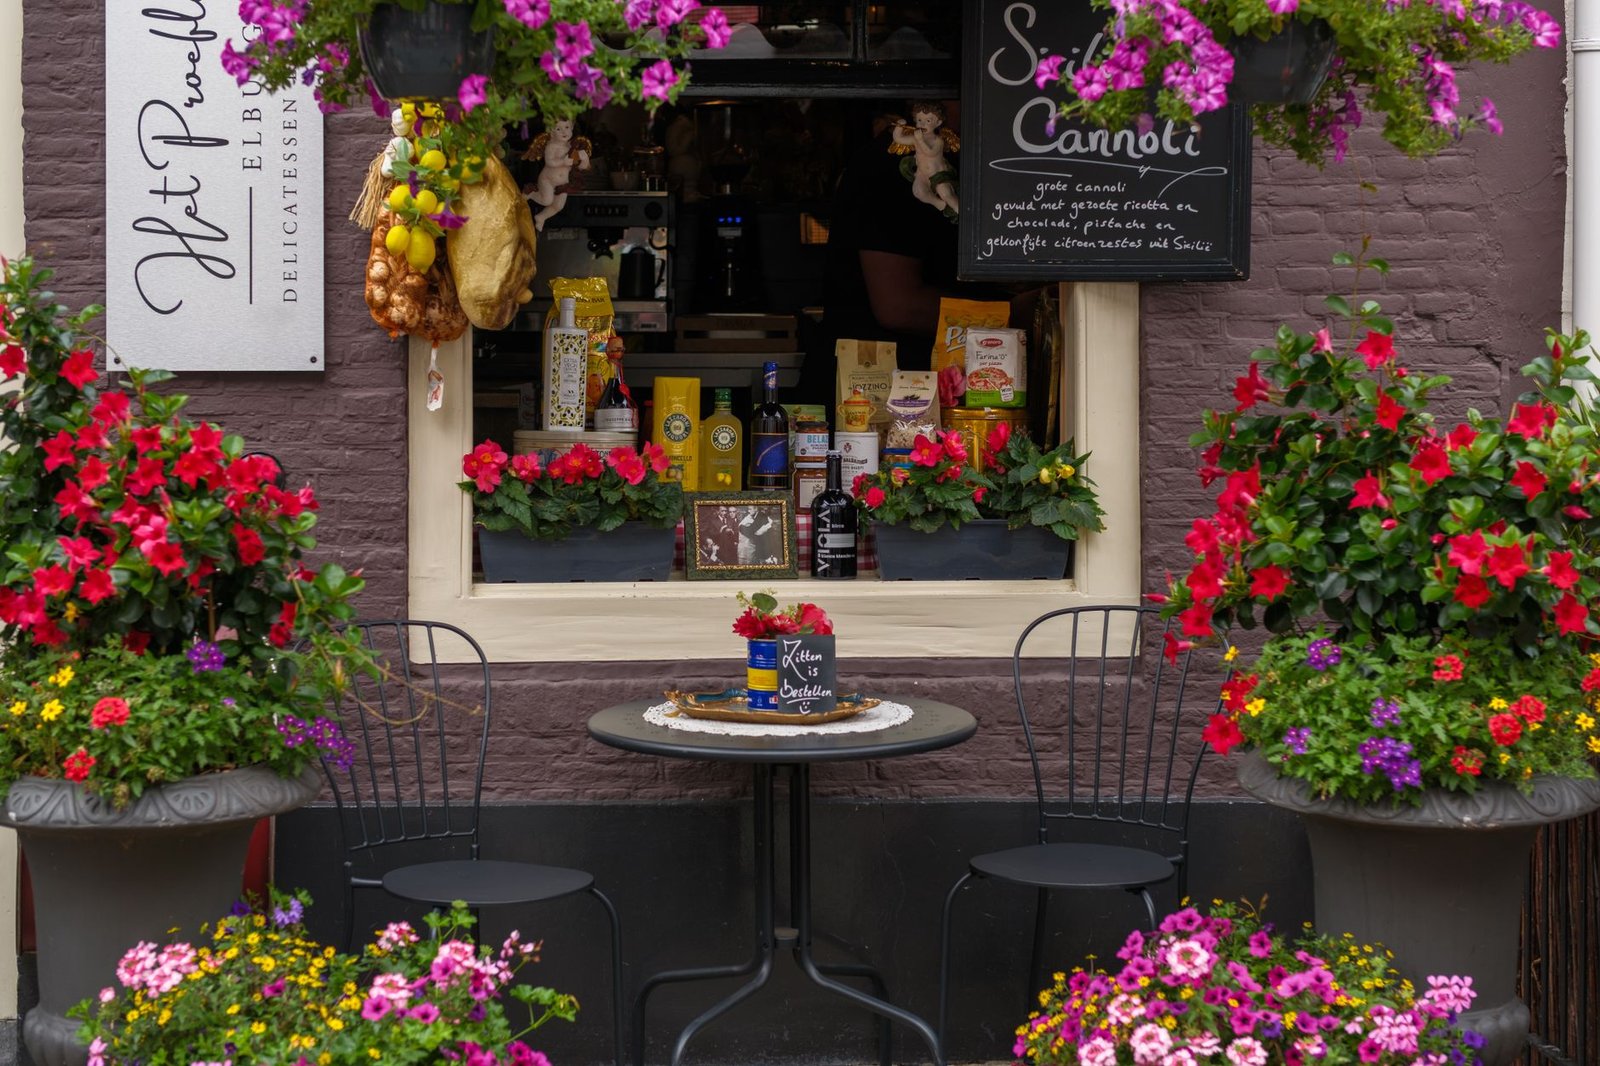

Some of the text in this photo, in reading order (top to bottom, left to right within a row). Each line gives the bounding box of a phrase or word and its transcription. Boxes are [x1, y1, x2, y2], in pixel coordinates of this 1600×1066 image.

[241, 24, 263, 171] ELBUG
[1012, 96, 1200, 159] Cannoli
[282, 98, 298, 303] DELICATESSEN
[1033, 181, 1127, 202] grote cannoli
[991, 200, 1037, 221] gevuld
[1041, 200, 1066, 211] met
[1124, 200, 1170, 211] ricotta
[1176, 203, 1200, 214] en
[1083, 218, 1147, 236] pistache
[1155, 221, 1176, 231] en
[131, 174, 237, 316] Het
[1149, 237, 1169, 250] uit
[975, 350, 998, 361] Farina
[817, 508, 831, 573] VIOLA
[807, 665, 818, 677] is
